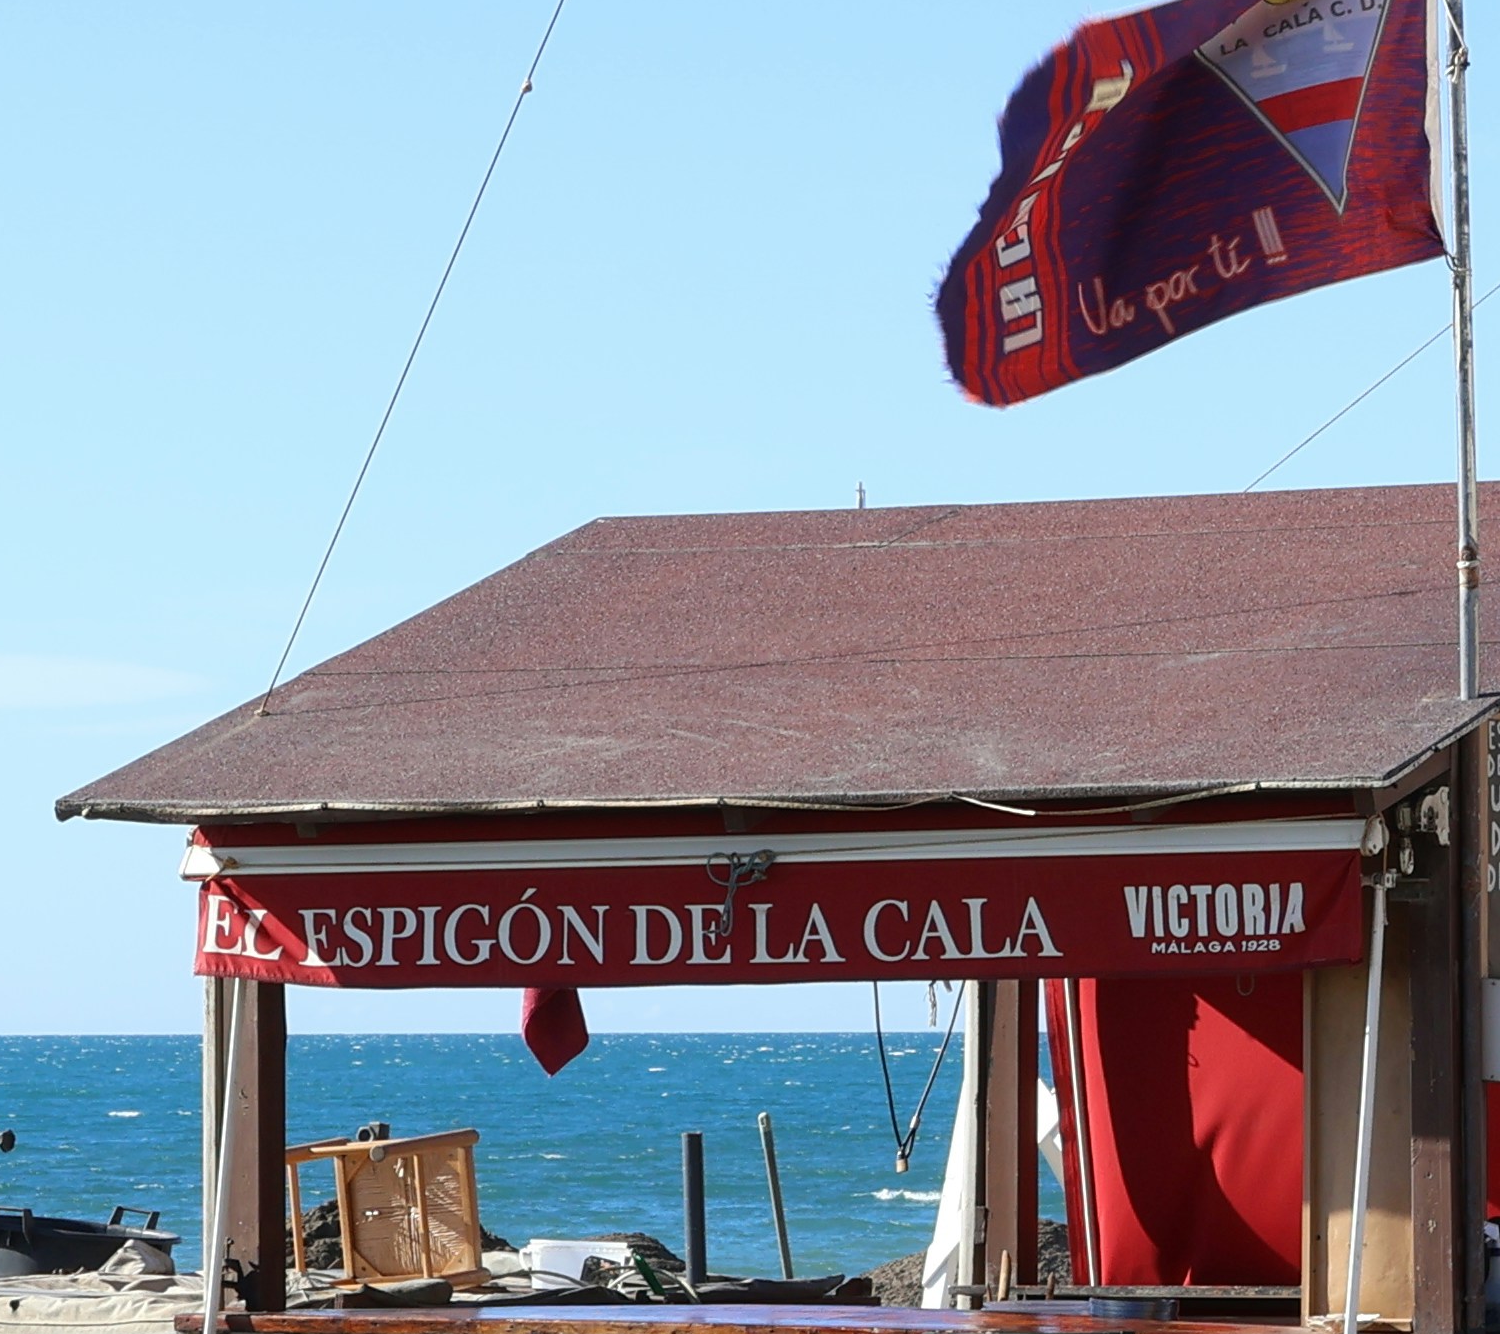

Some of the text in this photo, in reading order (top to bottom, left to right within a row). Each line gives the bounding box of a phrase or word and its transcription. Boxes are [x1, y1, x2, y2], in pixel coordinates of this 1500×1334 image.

[1219, 37, 1249, 57] LA
[1262, 6, 1324, 39] CALA
[1077, 276, 1136, 336] Va
[1145, 264, 1200, 336] por
[202, 887, 1064, 968] EL ESPIGÓN DE LA CALA
[1123, 881, 1307, 939] VICTORIA
[1151, 939, 1282, 954] MÁLAGA 1928
